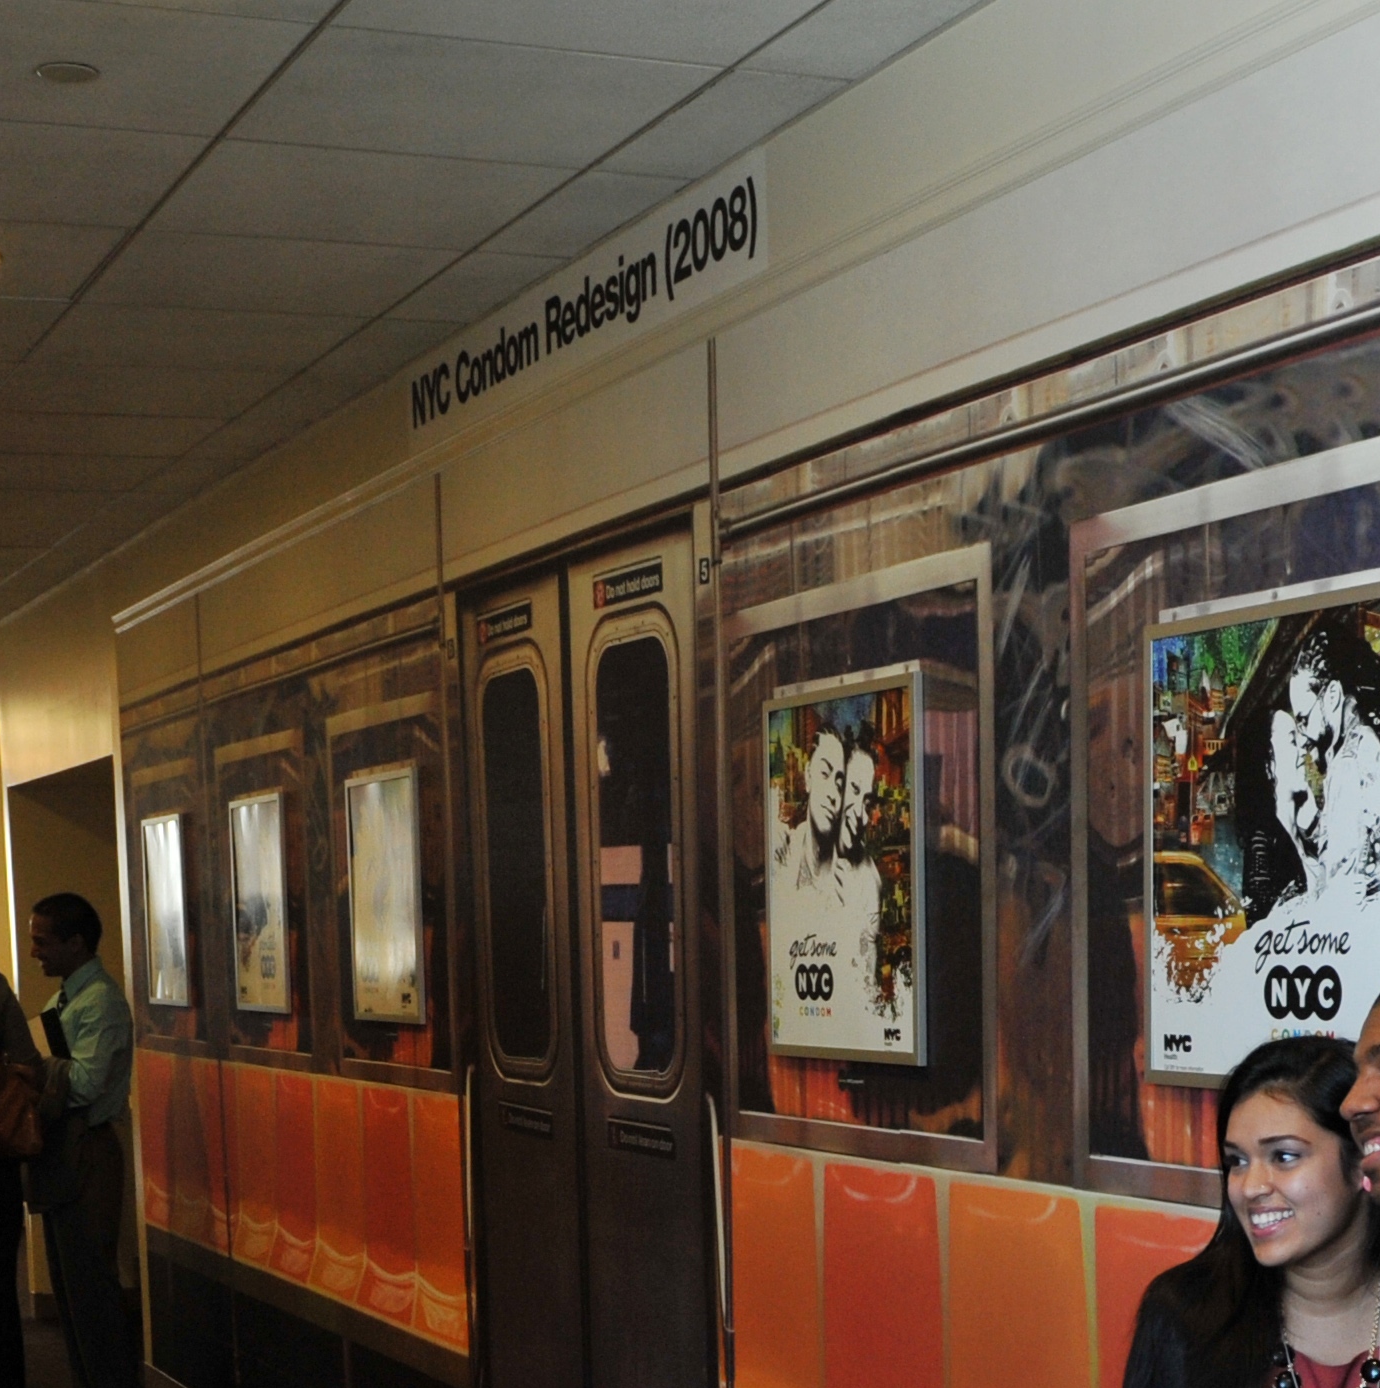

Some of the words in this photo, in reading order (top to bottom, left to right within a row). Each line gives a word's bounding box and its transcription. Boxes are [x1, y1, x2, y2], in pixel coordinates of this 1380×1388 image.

[411, 361, 451, 430] NYC
[455, 321, 540, 404] Condom
[545, 250, 657, 355] Redesign
[665, 175, 758, 301] (2008)
[641, 572, 660, 591] doors
[1254, 919, 1311, 975] get
[1298, 929, 1352, 956] some
[796, 971, 832, 995] NYC
[1268, 975, 1337, 1011] NYC
[883, 1027, 901, 1042] NYC
[1163, 1033, 1193, 1053] NYC
